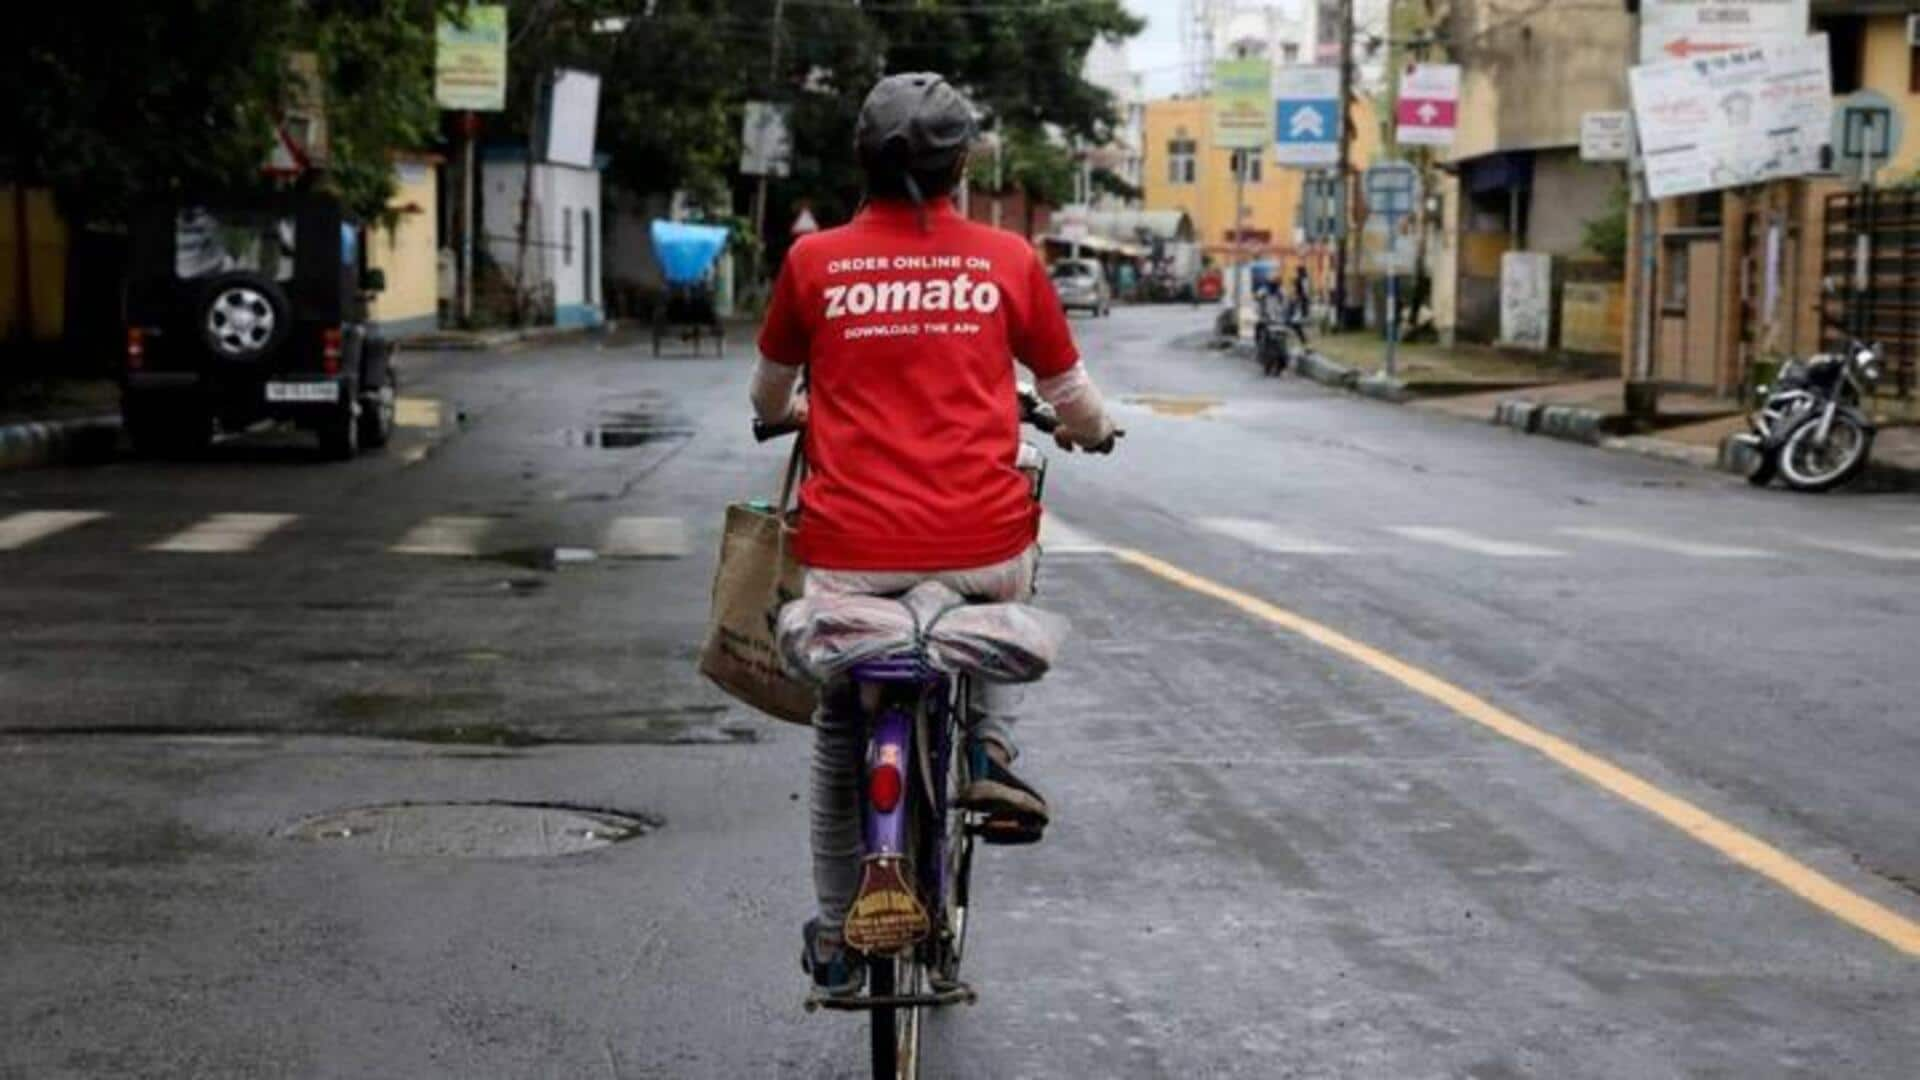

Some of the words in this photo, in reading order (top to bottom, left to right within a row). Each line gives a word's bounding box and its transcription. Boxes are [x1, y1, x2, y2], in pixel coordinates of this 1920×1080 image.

[827, 256, 889, 274] ORDER
[893, 255, 962, 270] ONLINE
[965, 256, 991, 272] ON
[823, 273, 1000, 320] zomato
[844, 323, 919, 340] DOWNLOAD
[924, 322, 949, 334] THE
[953, 322, 981, 334] APP
